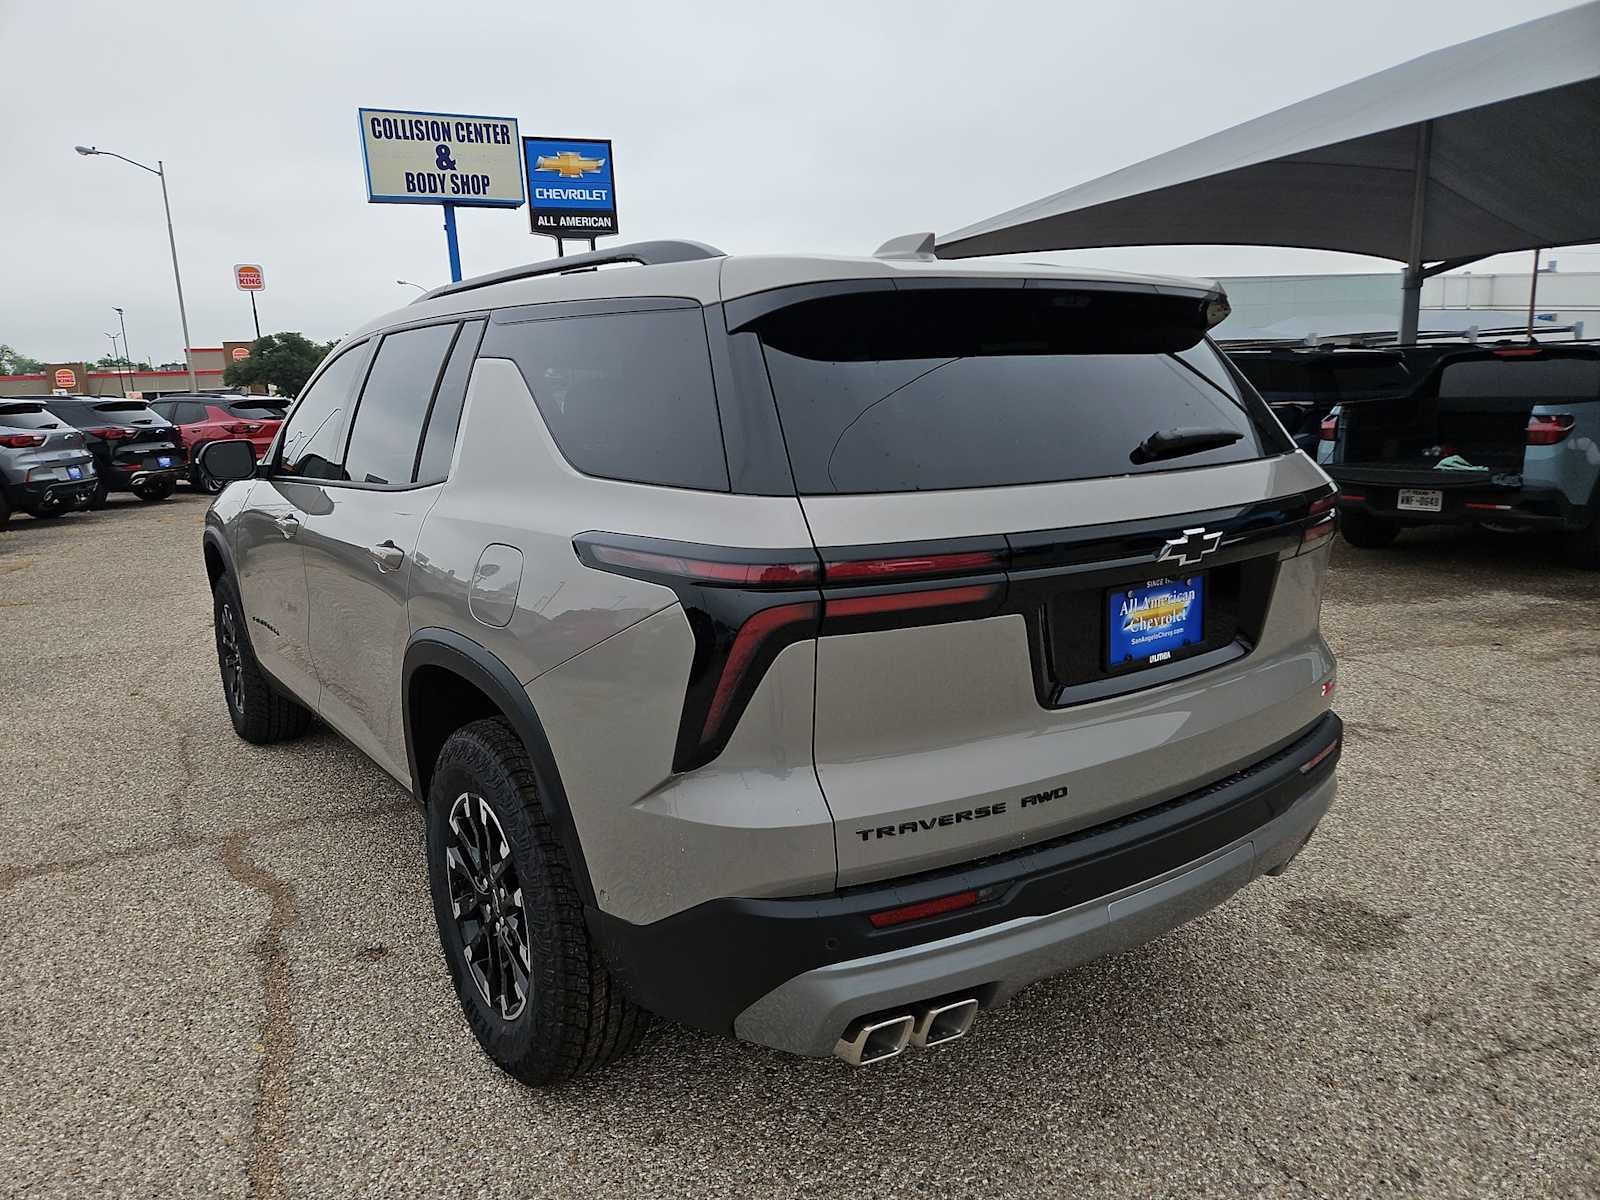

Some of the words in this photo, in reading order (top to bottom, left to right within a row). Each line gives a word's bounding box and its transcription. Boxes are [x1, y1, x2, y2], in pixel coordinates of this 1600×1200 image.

[370, 117, 451, 142] COLLISION
[455, 120, 511, 145] CENTER
[434, 143, 457, 171] &
[404, 171, 446, 194] BODY
[450, 172, 491, 196] SHOP
[535, 187, 608, 202] CHEVROLET
[537, 215, 557, 227] ALL
[559, 215, 612, 228] AMERICAN
[1119, 597, 1138, 616] All
[1142, 590, 1195, 611] American
[1130, 608, 1187, 633] Chevrolet
[856, 802, 1007, 842] TRAVERSE
[1021, 786, 1069, 808] AWD
